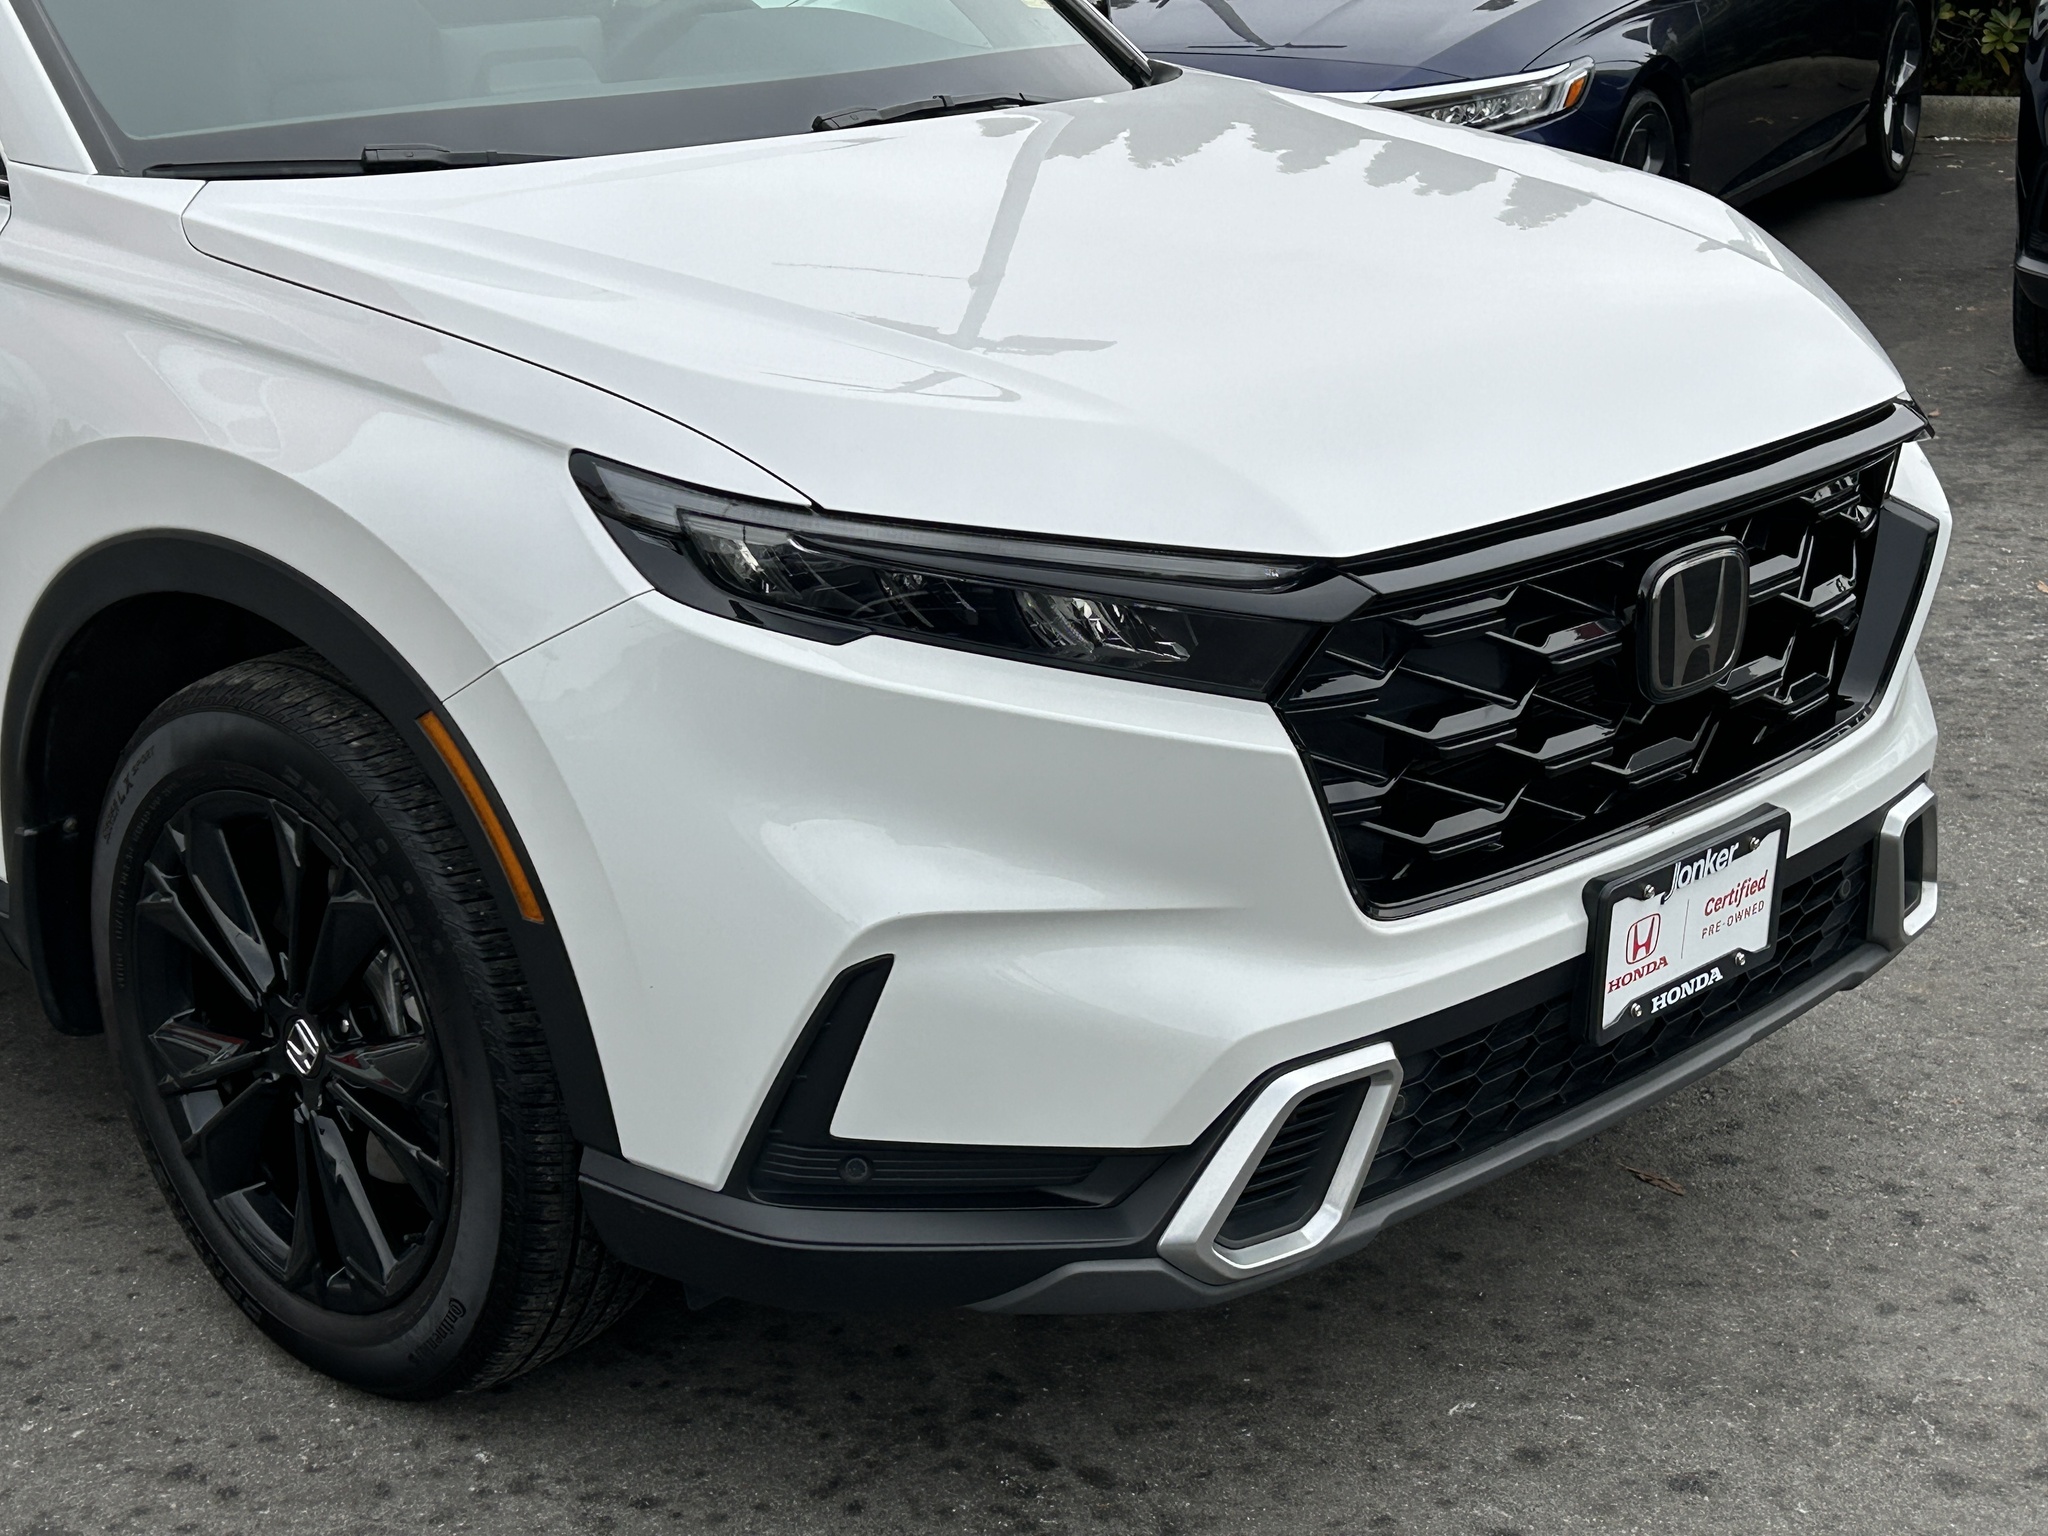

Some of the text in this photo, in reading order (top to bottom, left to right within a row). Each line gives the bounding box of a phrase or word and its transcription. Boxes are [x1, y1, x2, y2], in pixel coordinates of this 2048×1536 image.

[1660, 842, 1740, 905] Jonker
[1704, 868, 1769, 917] Certified
[1701, 899, 1765, 940] PRE-OWNED
[1607, 955, 1669, 994] HONDA
[1650, 966, 1724, 1014] HONDA
